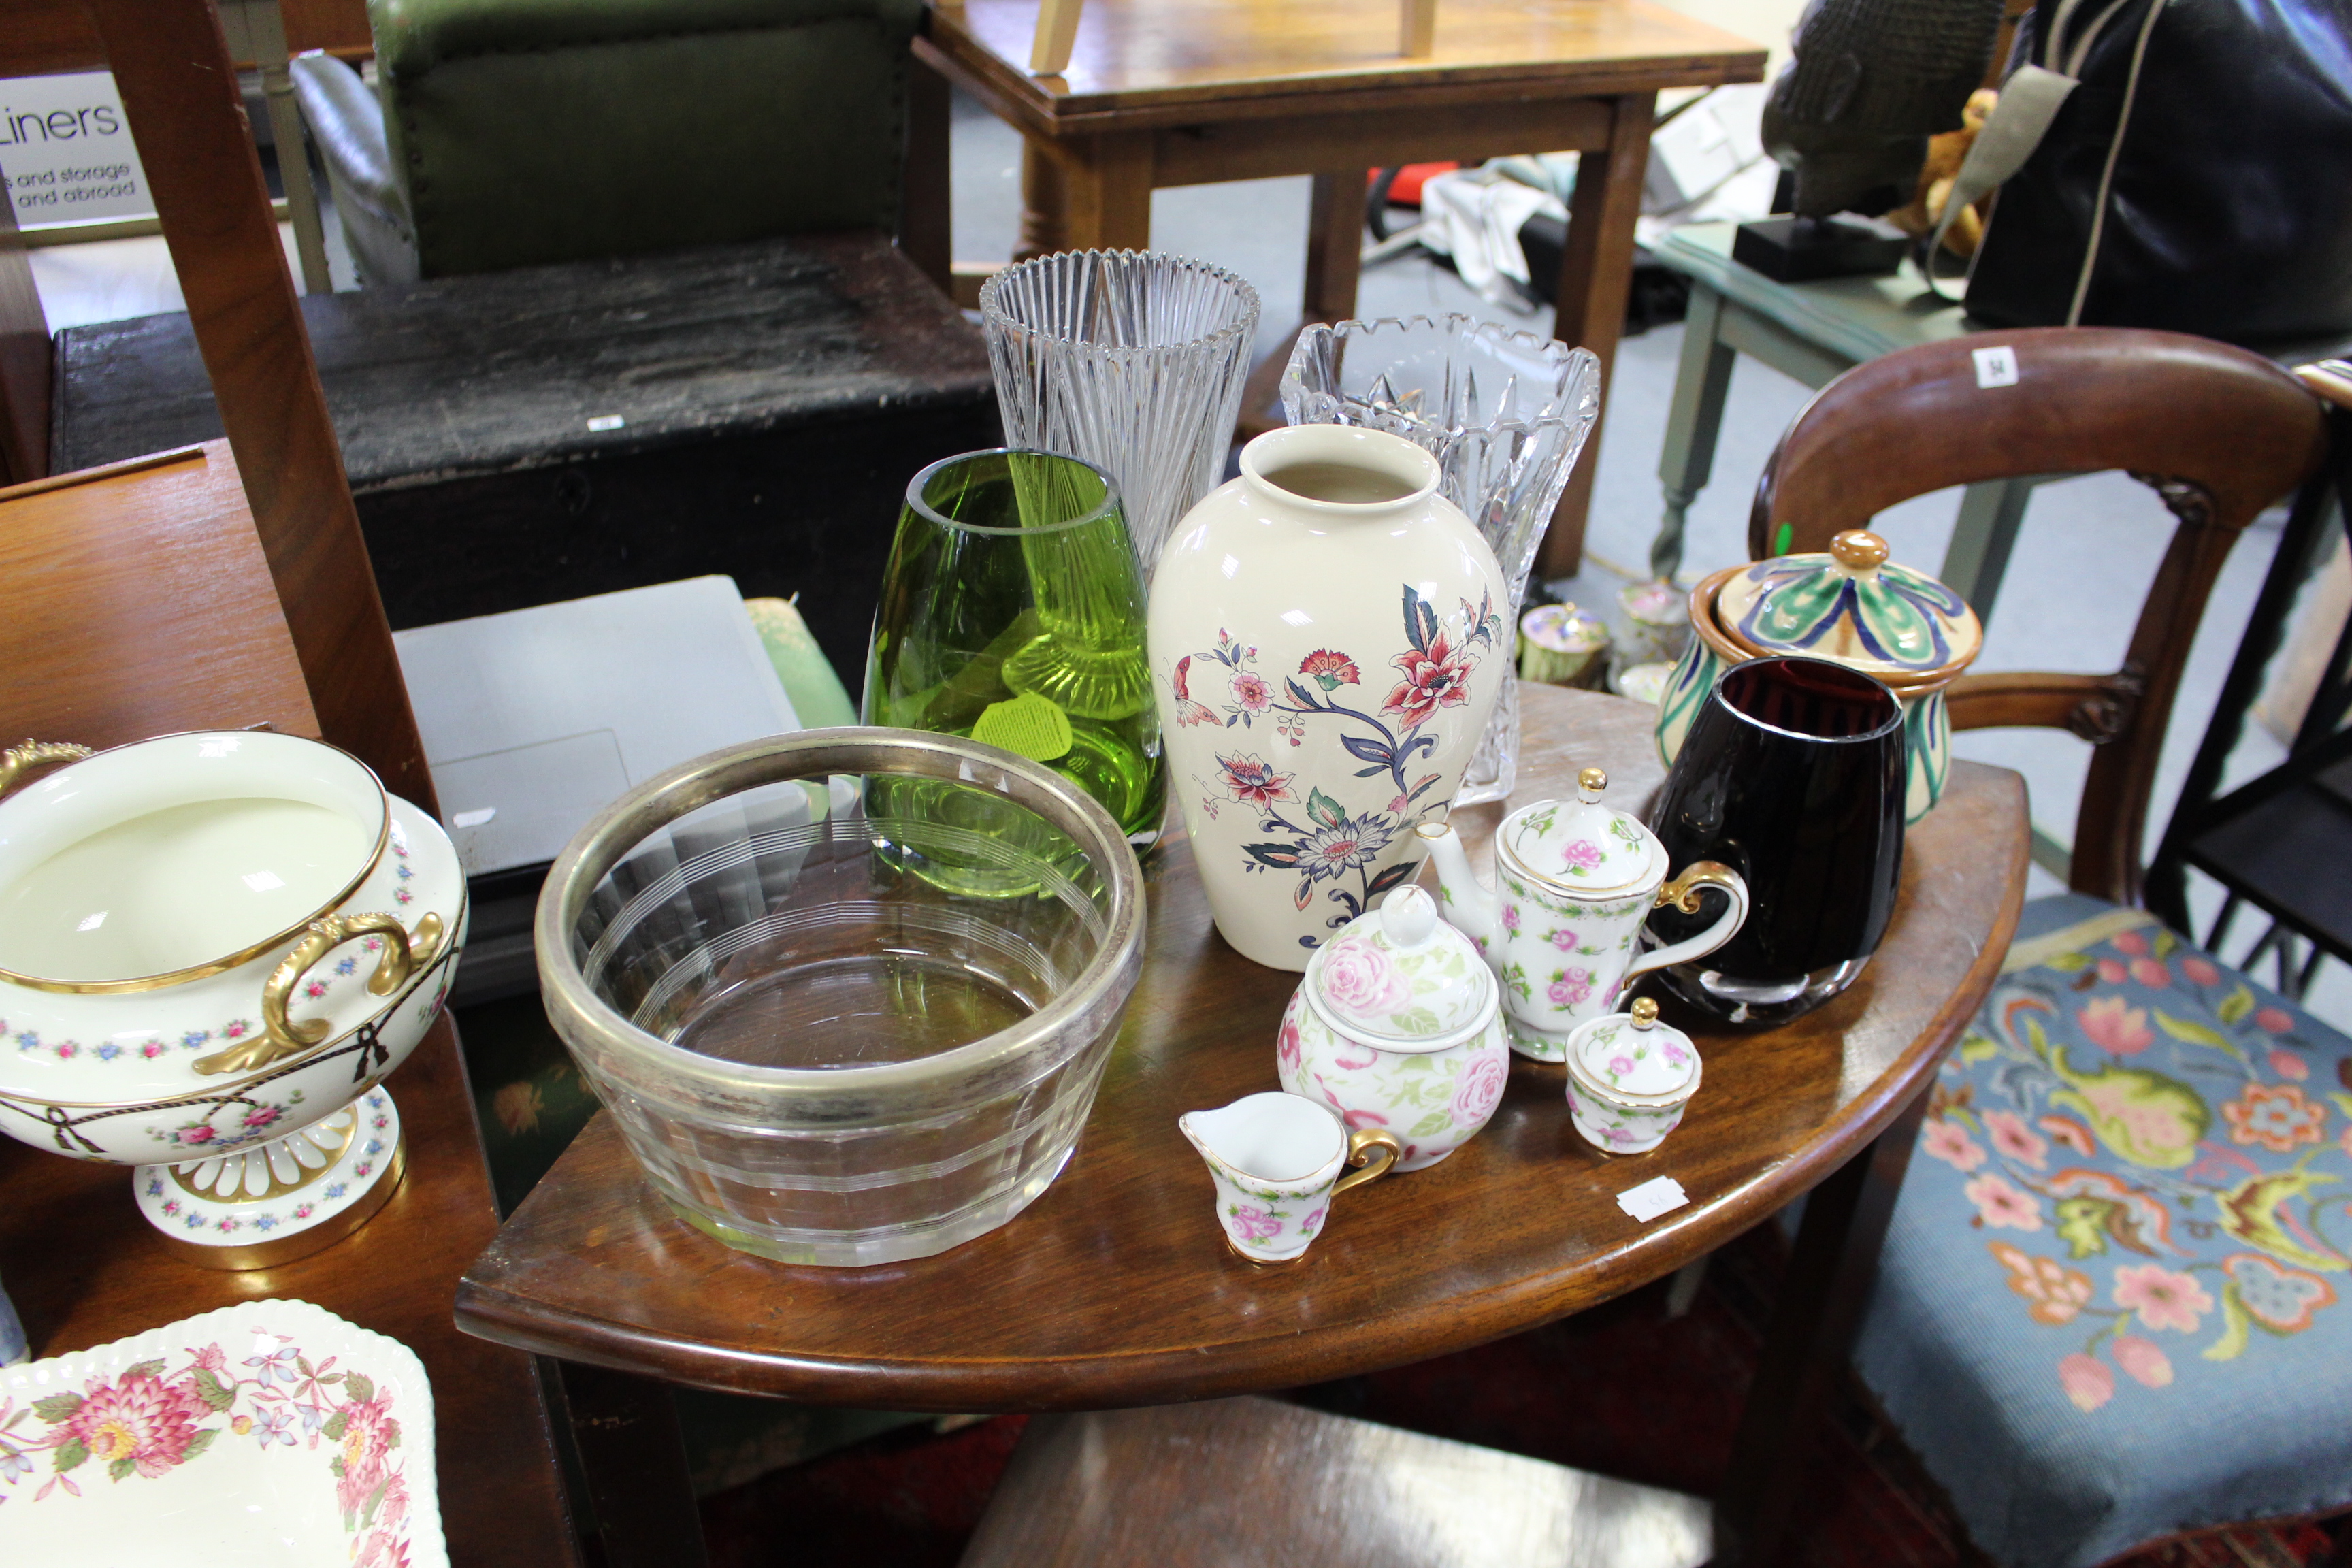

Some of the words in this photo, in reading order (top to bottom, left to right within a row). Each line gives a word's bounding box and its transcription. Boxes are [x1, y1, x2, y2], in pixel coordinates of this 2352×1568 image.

[17, 169, 56, 188] and
[61, 163, 130, 182] storage
[18, 189, 57, 208] and
[63, 180, 135, 203] abroad
